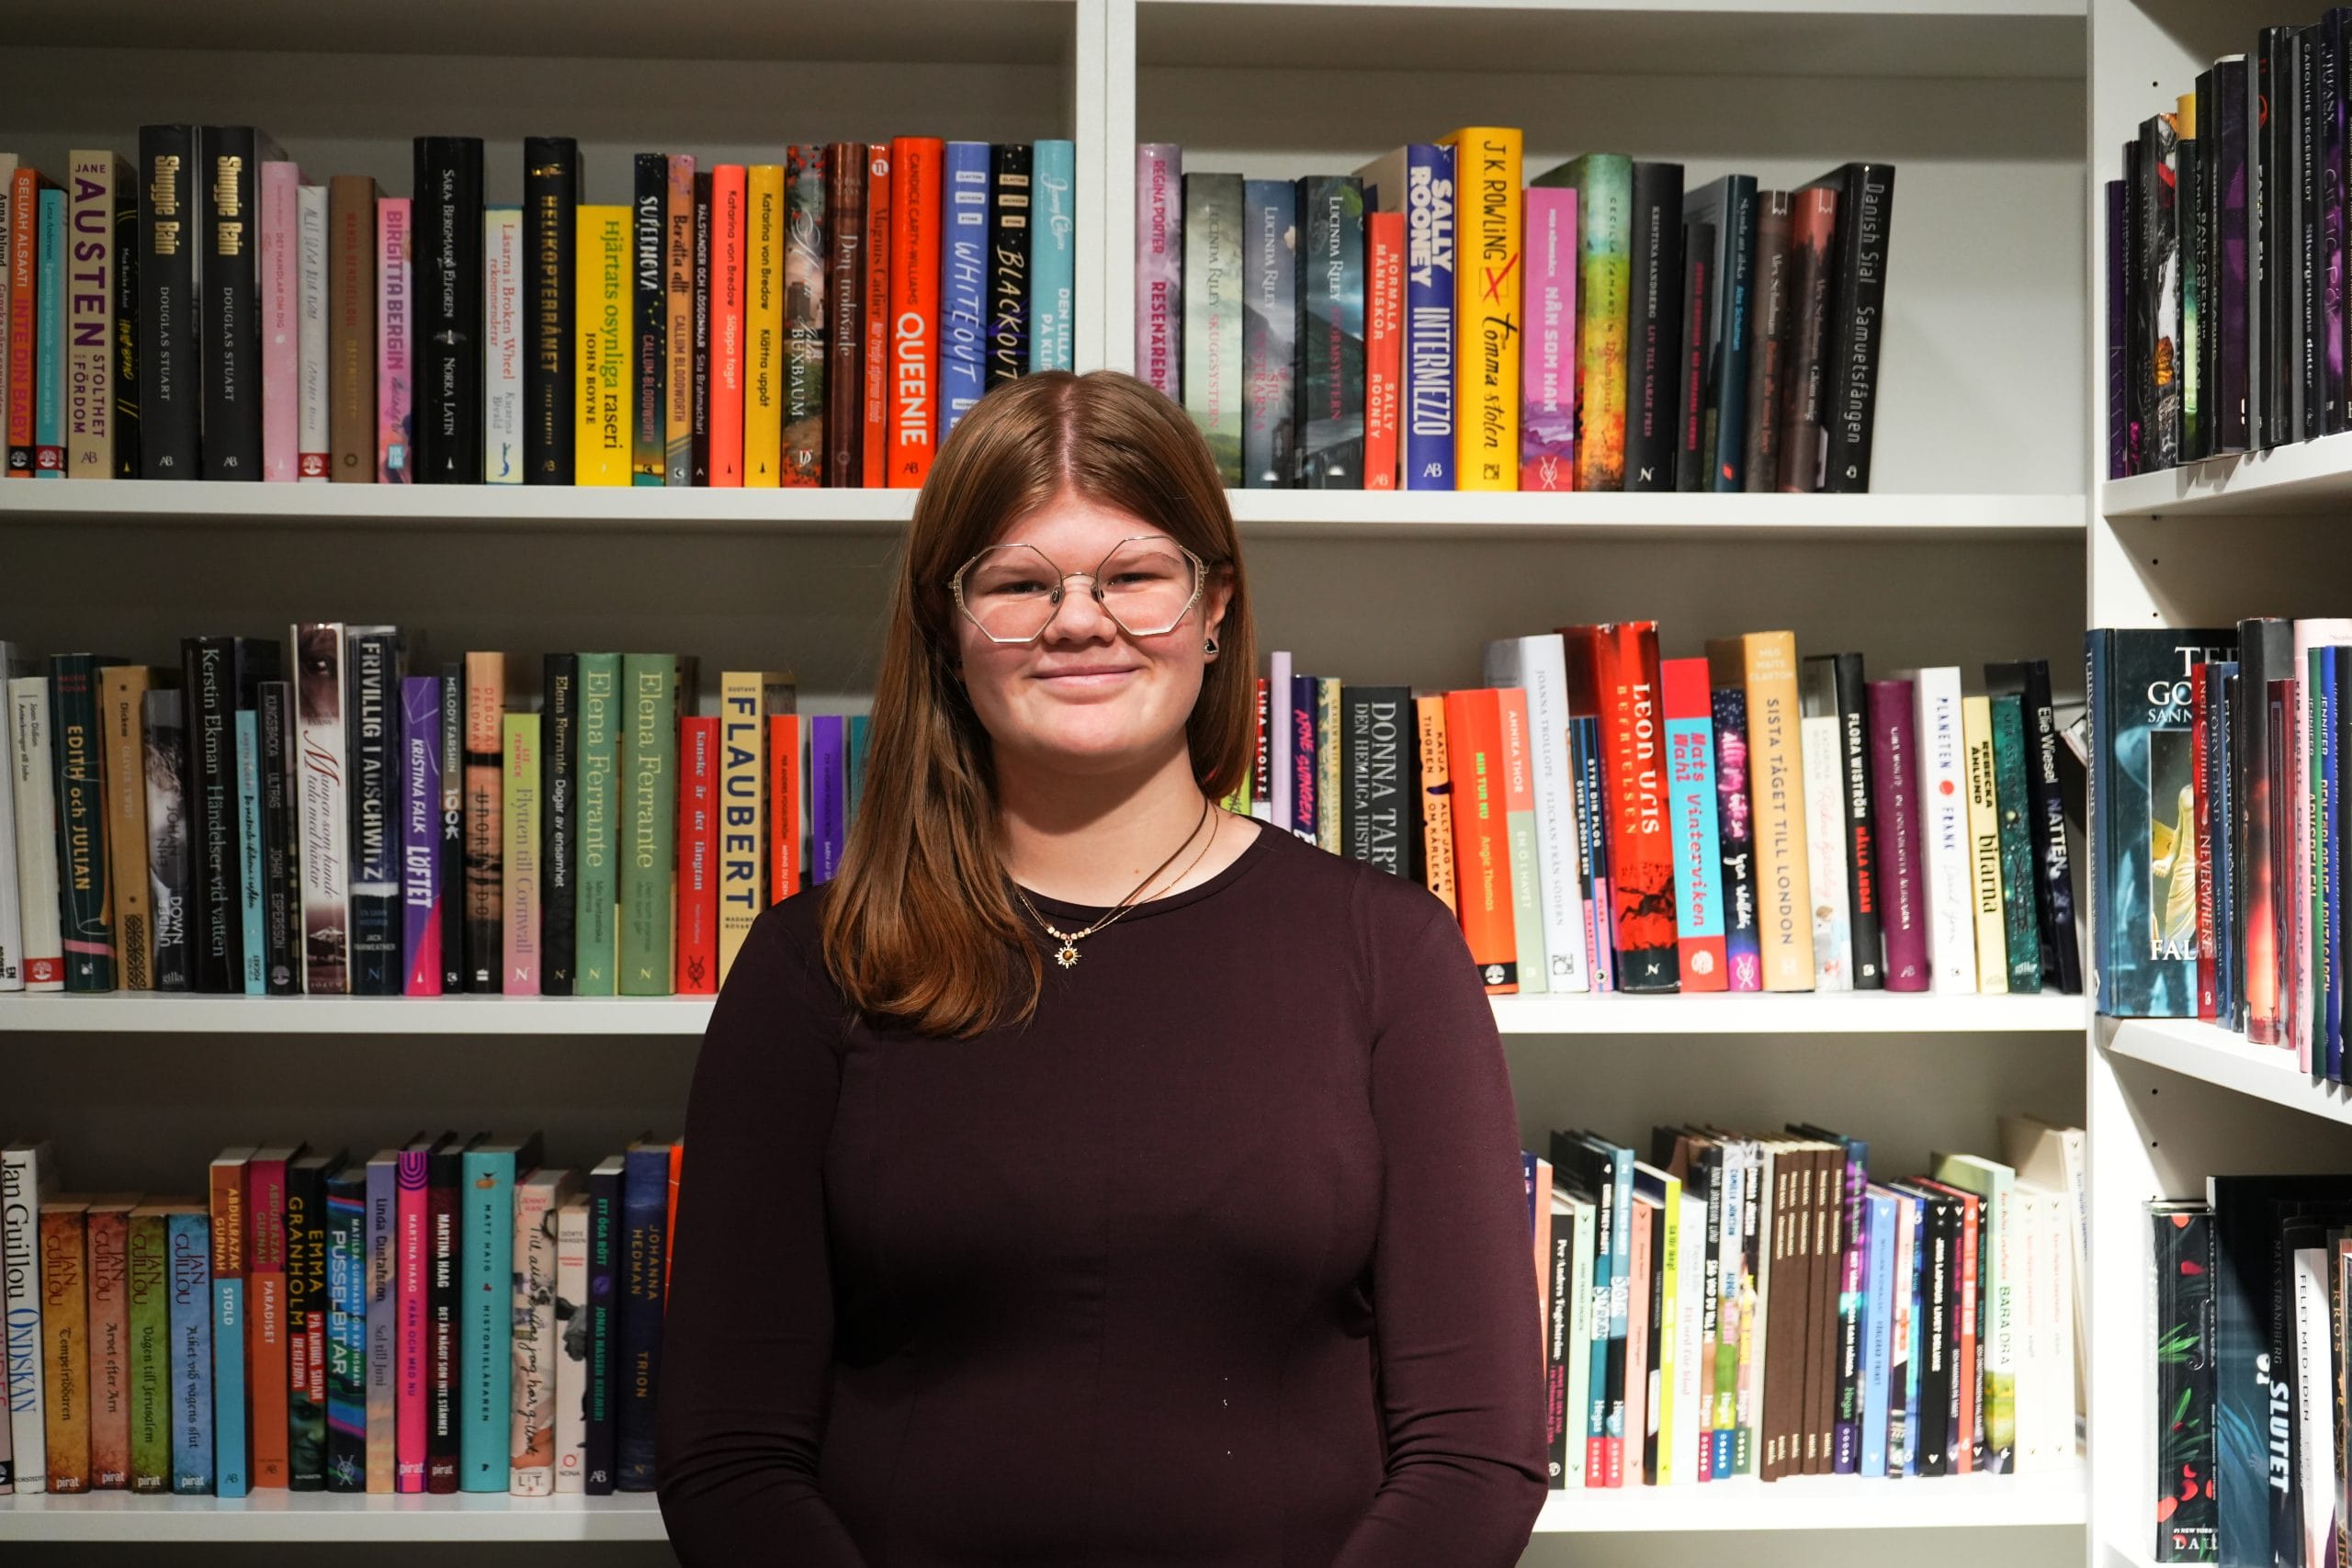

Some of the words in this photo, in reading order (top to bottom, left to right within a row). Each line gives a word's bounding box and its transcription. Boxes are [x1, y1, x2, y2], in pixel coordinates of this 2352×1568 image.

[74, 164, 106, 174] JANE
[151, 155, 180, 217] Shuggie
[214, 155, 243, 217] Shuggie
[443, 170, 455, 198] SARA
[908, 153, 921, 206] CANDICE
[1152, 160, 1166, 203] REGINA
[18, 177, 29, 230] SELUAH
[761, 193, 773, 242] Katarina
[1152, 207, 1166, 253] PORTER
[1410, 166, 1432, 288] ROONEY
[1432, 178, 1453, 272] SALLY
[1862, 184, 1884, 243] Danish
[17, 232, 28, 287] ALSAATI
[74, 177, 106, 347] AUSTEN
[154, 220, 180, 254] Bain
[218, 221, 243, 256] Bain
[387, 210, 403, 296] BIRGITTA
[443, 204, 455, 267] BERGMARK
[503, 223, 515, 275] Läsarna
[600, 220, 624, 299] Hjärtats
[639, 196, 658, 291] SUPERNOVA
[762, 245, 771, 265] von
[907, 209, 920, 306] CARTY-WILLIAMS
[443, 270, 455, 318] ELFGREN
[541, 196, 561, 373] HELIKOPTERRÅNET
[761, 267, 771, 310] Bredow
[1374, 244, 1386, 340] MÄNNISKOR
[1386, 254, 1397, 332] NORMALA
[1859, 252, 1879, 284] Sial
[14, 299, 29, 344] INTE
[160, 287, 170, 347] DOUGLAS
[223, 288, 233, 347] DOUGLAS
[503, 288, 515, 333] Broken
[953, 241, 981, 383] WHITEOUT
[996, 244, 1024, 380] BLACKOUT
[1041, 313, 1054, 334] PÅ
[1058, 288, 1070, 319] DEN
[387, 300, 403, 370] BERGIN
[503, 338, 515, 380] Wheel
[585, 333, 597, 372] JOHN
[600, 304, 623, 389] osynliga
[760, 329, 771, 367] Klättra
[1058, 323, 1070, 363] LILLA
[14, 348, 29, 384] DIN
[160, 350, 170, 401] STUART
[223, 351, 233, 402] STUART
[444, 357, 455, 397] NORRA
[757, 371, 771, 407] uppåt
[791, 328, 805, 417] BUXBAUM
[897, 312, 927, 446] QUEENIE
[1413, 307, 1452, 436] INTERMEZZO
[2305, 338, 2314, 387] dotter
[13, 389, 28, 439] BABY
[74, 361, 87, 434] FÖRDOM
[93, 354, 105, 438] STOLTHET
[444, 402, 455, 435] LATIN
[585, 377, 597, 425] BOYNE
[605, 394, 624, 449] raseri
[1371, 373, 1382, 439] ROONEY
[1384, 382, 1395, 431] SALLY
[200, 649, 220, 708] Kerstin
[362, 642, 381, 738] FRIVILLIG
[447, 677, 457, 724] MELODY
[587, 671, 611, 747] Elena
[639, 671, 662, 748] Elena
[1257, 690, 1267, 726] LINA
[1355, 703, 1368, 734] DEN
[1767, 698, 1782, 747] SISTA
[1848, 713, 1862, 755] FLORA
[2037, 706, 2052, 732] Elie
[67, 726, 85, 779] EDITH
[204, 715, 223, 774] Ekman
[412, 739, 424, 797] KRISTINA
[447, 726, 457, 773] FARSHIN
[1257, 737, 1267, 794] STOLTZ
[1371, 701, 1396, 800] DONNA
[1674, 734, 1690, 783] Wahl
[1691, 733, 1707, 782] Mats
[2041, 734, 2057, 784] Wiesel
[553, 779, 566, 813] Dagar
[1354, 739, 1369, 809] HEMLIGA
[1770, 755, 1787, 812] TÅGET
[1849, 756, 1867, 818] WISTRÖM
[71, 787, 85, 818] och
[206, 785, 225, 870] Händelser
[413, 800, 426, 833] FALK
[444, 789, 459, 840] 100K
[512, 788, 533, 846] Flytten
[556, 816, 564, 829] av
[586, 752, 610, 868] Ferrante
[637, 753, 661, 868] Ferrante
[726, 697, 755, 909] FLAUBERT
[73, 825, 90, 889] JULIAN
[555, 831, 566, 887] ensamhet
[1774, 819, 1787, 858] TILL
[1855, 827, 1870, 866] HÅLLA
[2046, 797, 2067, 870] NATTEN
[406, 845, 433, 908] LÖFTET
[516, 851, 533, 874] till
[1686, 795, 1707, 927] Vinterviken
[1978, 834, 1999, 913] bitarna
[210, 876, 228, 902] vid
[515, 877, 533, 953] Cornwall
[1777, 866, 1793, 945] LONDON
[1859, 870, 1871, 913] ANDAN
[2200, 834, 2214, 953] NEVERWHERE
[211, 908, 227, 956] vatten
[2, 1160, 27, 1198] Jan
[228, 1189, 240, 1269] ABDULRAZAK
[375, 1199, 387, 1231] Linda
[409, 1214, 417, 1259] MARTINA
[436, 1214, 449, 1258] MARTINA
[483, 1204, 492, 1235] MATT
[4, 1203, 29, 1300] Guillou
[47, 1235, 63, 1306] GUILLOU
[95, 1230, 110, 1302] GUILLOU
[109, 1252, 125, 1281] JAN
[132, 1234, 148, 1304] GUILLOU
[147, 1256, 163, 1284] JAN
[175, 1234, 190, 1304] GUILLOU
[190, 1255, 206, 1284] JAN
[215, 1218, 225, 1270] GURNAH
[289, 1197, 304, 1326] GRANHOLM
[308, 1230, 324, 1292] EMMA
[375, 1235, 387, 1303] Gustafsson
[483, 1243, 492, 1272] HAIG
[632, 1229, 643, 1294] HEDMAN
[648, 1224, 660, 1301] JOHANNA
[62, 1256, 77, 1286] JAN
[436, 1261, 449, 1288] HAAG
[265, 1280, 275, 1344] PARADISET
[332, 1230, 347, 1374] PUSSELBITAR
[2273, 1279, 2282, 1364] STRANDBERG
[6, 1308, 40, 1413] ONDSKAN
[145, 1366, 155, 1382] till
[637, 1351, 649, 1397] TRION
[1590, 1400, 1604, 1433] Hegas
[2269, 1380, 2289, 1494] SLUTET
[56, 1476, 80, 1488] pirat
[101, 1472, 125, 1484] pirat
